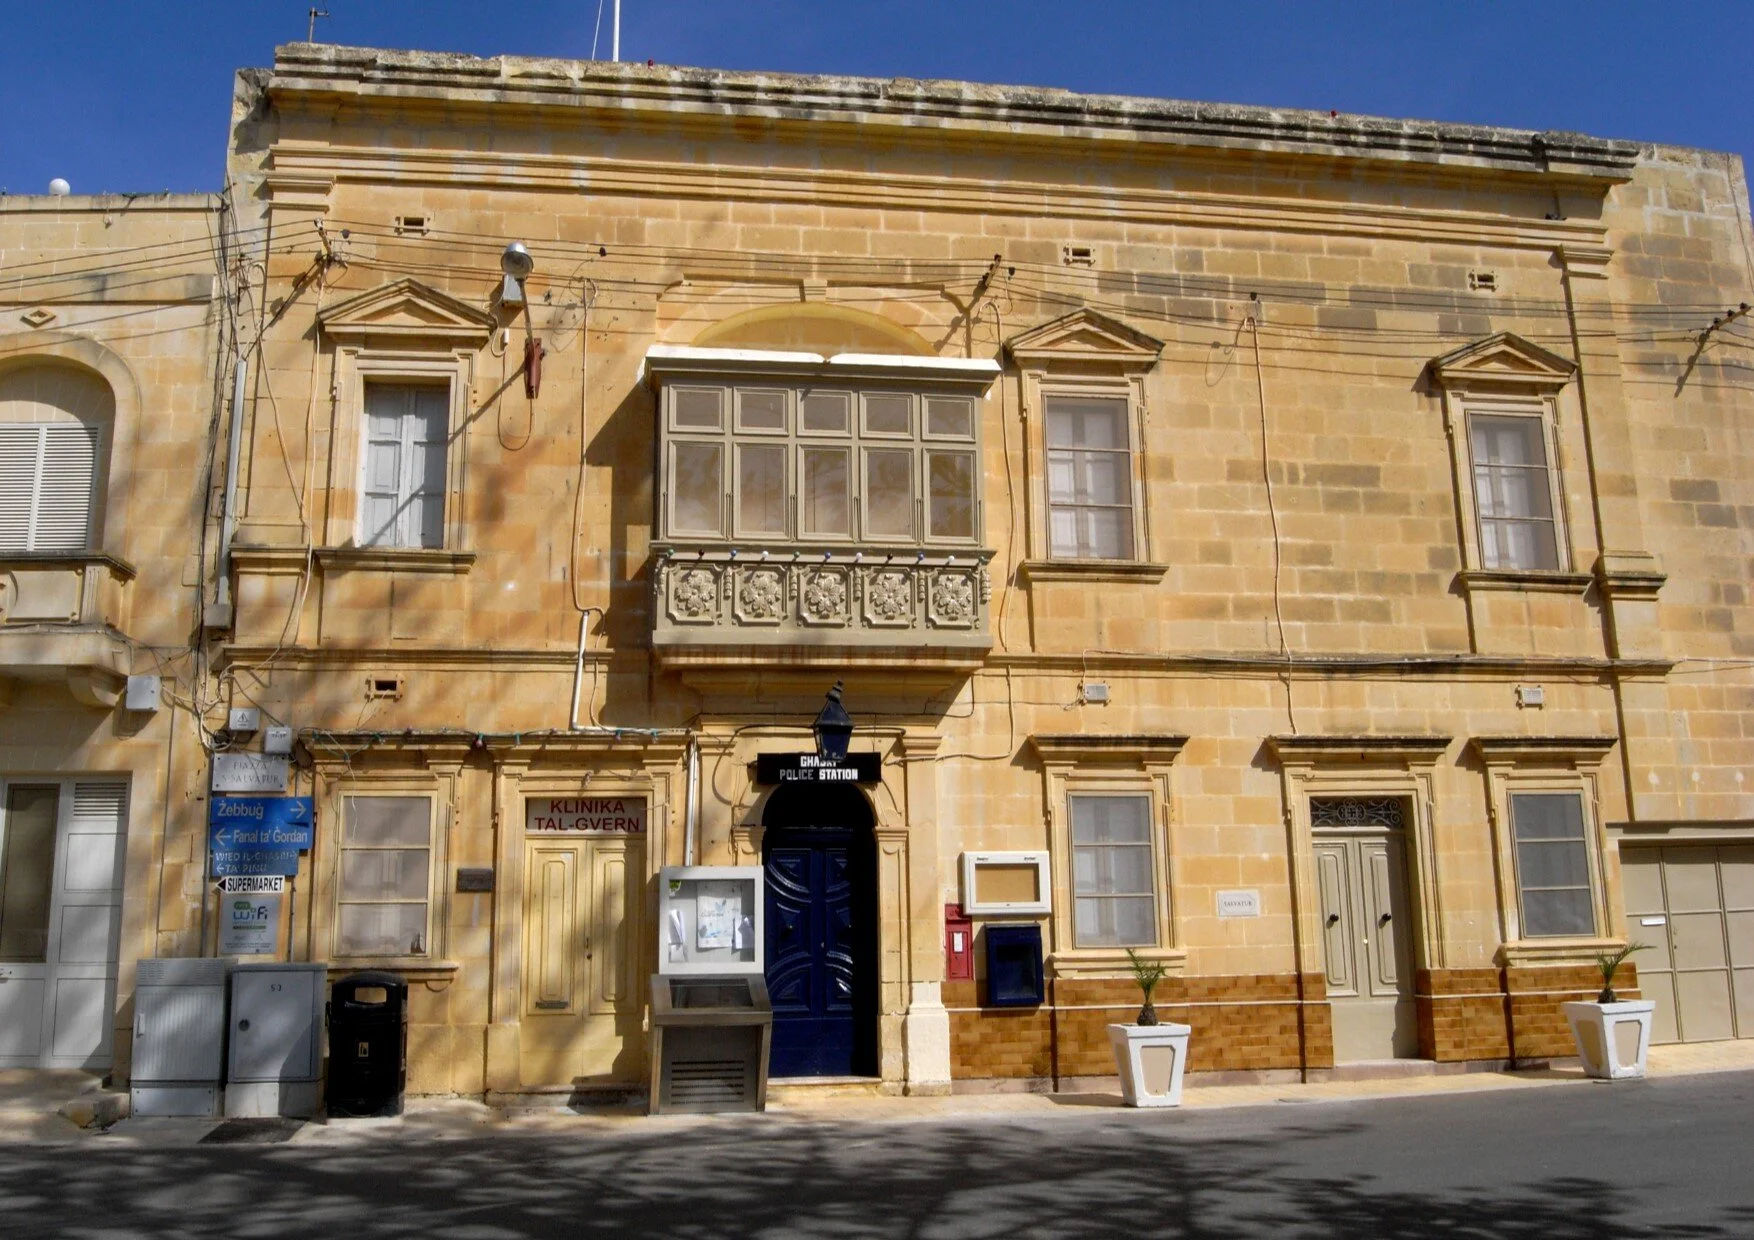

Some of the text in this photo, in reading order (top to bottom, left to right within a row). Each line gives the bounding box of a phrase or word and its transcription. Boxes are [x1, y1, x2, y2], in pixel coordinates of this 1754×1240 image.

[779, 768, 859, 780] POLICE STATION
[217, 800, 264, 820] Żebbuġ
[550, 800, 625, 814] KLINIKA
[534, 817, 640, 832] TAL-GVERN
[233, 826, 308, 843] Fanal ta' Ġordan
[215, 852, 240, 862] WIED
[227, 877, 284, 892] SUPERMARKET
